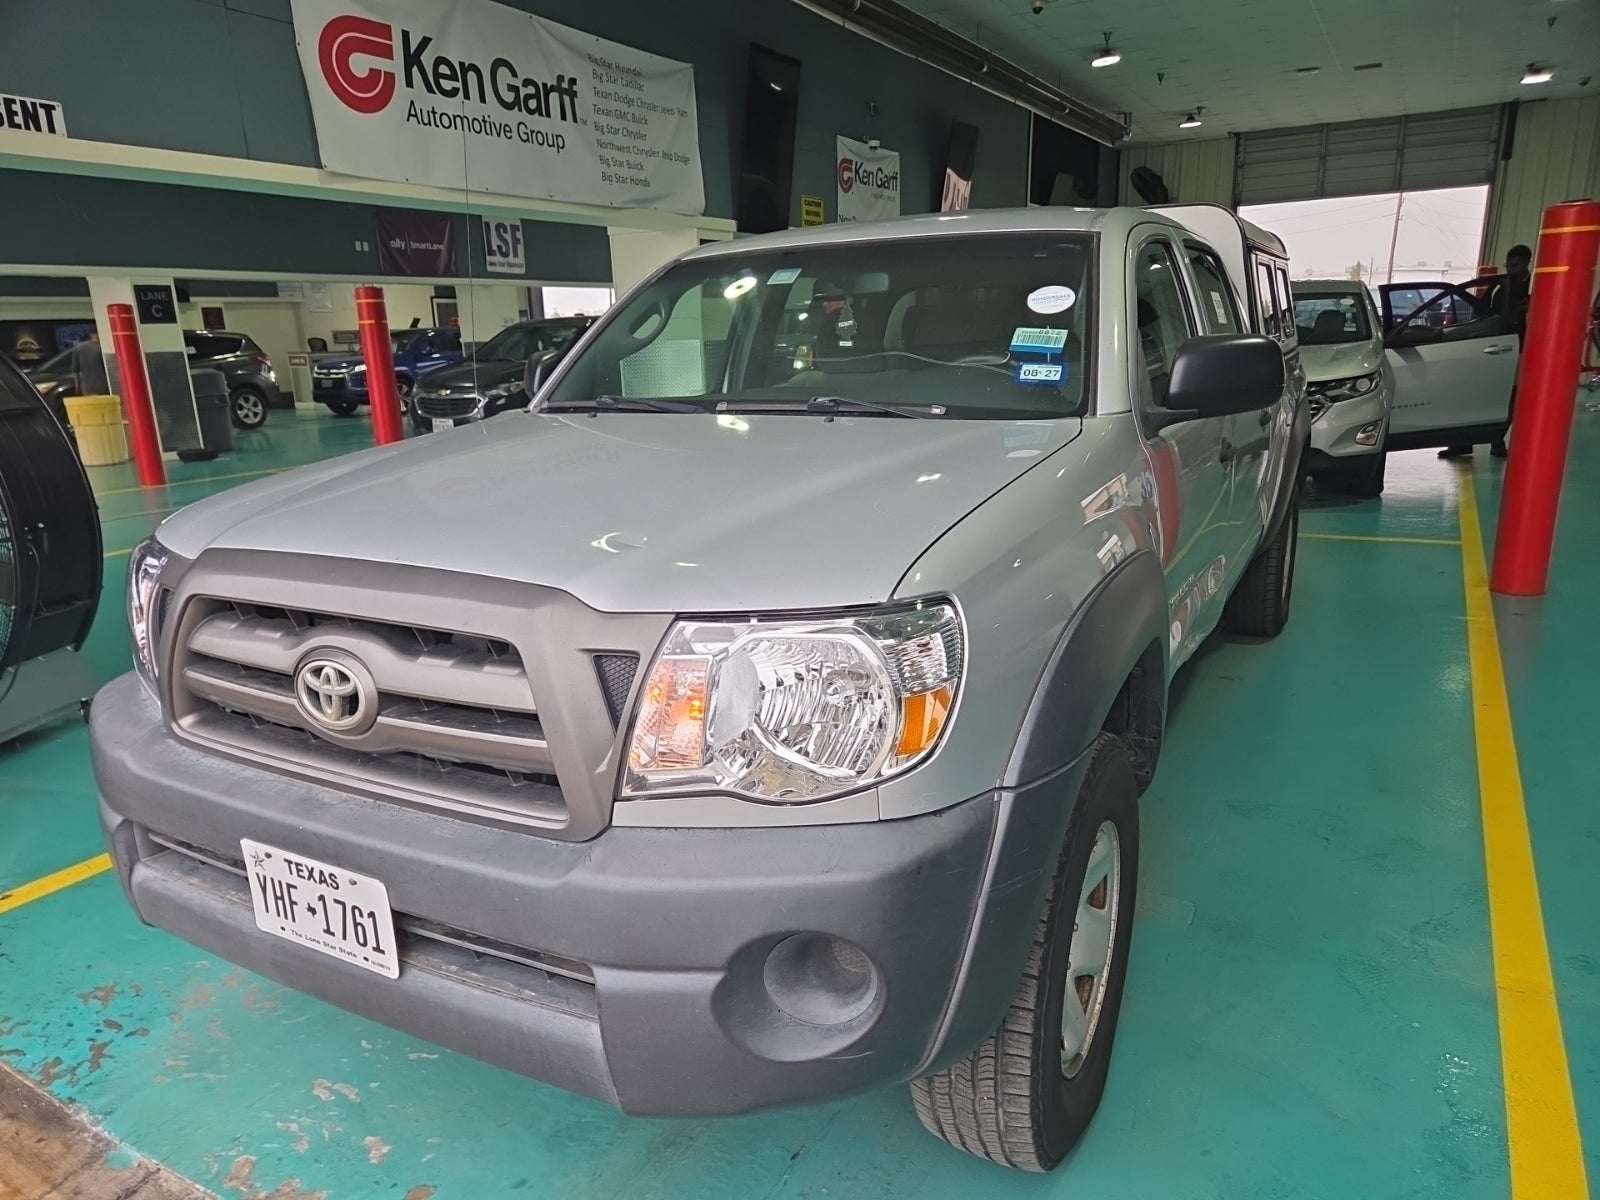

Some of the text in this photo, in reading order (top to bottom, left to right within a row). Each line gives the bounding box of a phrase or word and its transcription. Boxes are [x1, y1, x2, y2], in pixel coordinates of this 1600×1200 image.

[401, 29, 487, 104] Ken
[490, 57, 578, 124] Garff
[592, 68, 645, 92] Big Star Cadillac
[592, 86, 613, 100] Texan
[614, 91, 635, 107] Dodge
[636, 97, 660, 112] Chrysler
[406, 99, 566, 154] Automotive Group
[592, 103, 649, 126] Texan GMC Buick
[593, 121, 647, 141] Big Star Chrysler
[596, 138, 632, 154] Northwest
[632, 145, 660, 158] Chrysler
[661, 149, 674, 162] Jeep
[599, 155, 644, 171] Big Star Buick
[601, 171, 650, 188] Big Star Honda
[854, 160, 898, 192] Ken Garff
[390, 238, 405, 251] ally
[484, 221, 521, 259] LSF
[140, 291, 169, 301] LANE
[152, 304, 163, 318] C
[284, 858, 340, 891] TEXAS
[256, 872, 386, 956] YHF 1761
[290, 929, 358, 959] The Lone Star State
